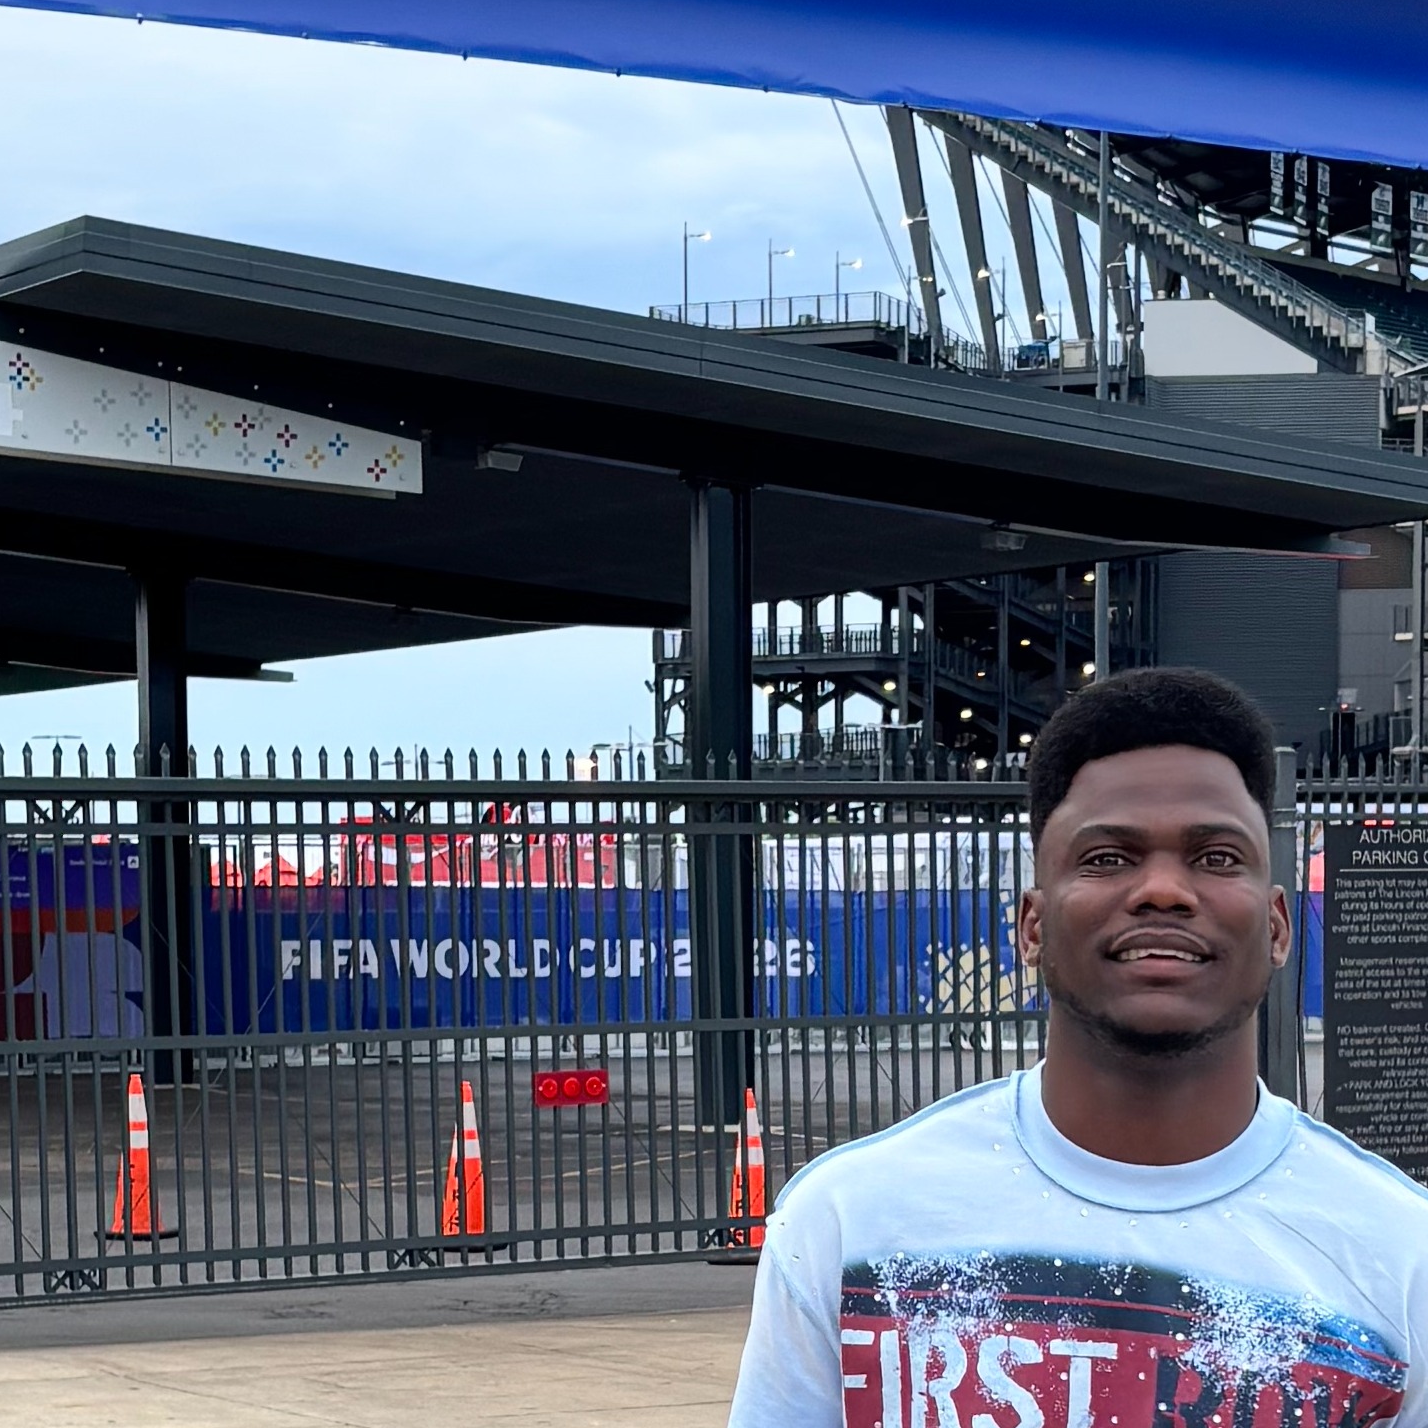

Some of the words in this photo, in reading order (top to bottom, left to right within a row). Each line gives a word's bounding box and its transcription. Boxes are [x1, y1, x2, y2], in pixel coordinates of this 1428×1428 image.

[1352, 850, 1419, 864] PARKING
[280, 939, 380, 980] FIFA
[390, 938, 560, 979] WORLD
[569, 938, 657, 978] CUP
[664, 938, 818, 979] 226
